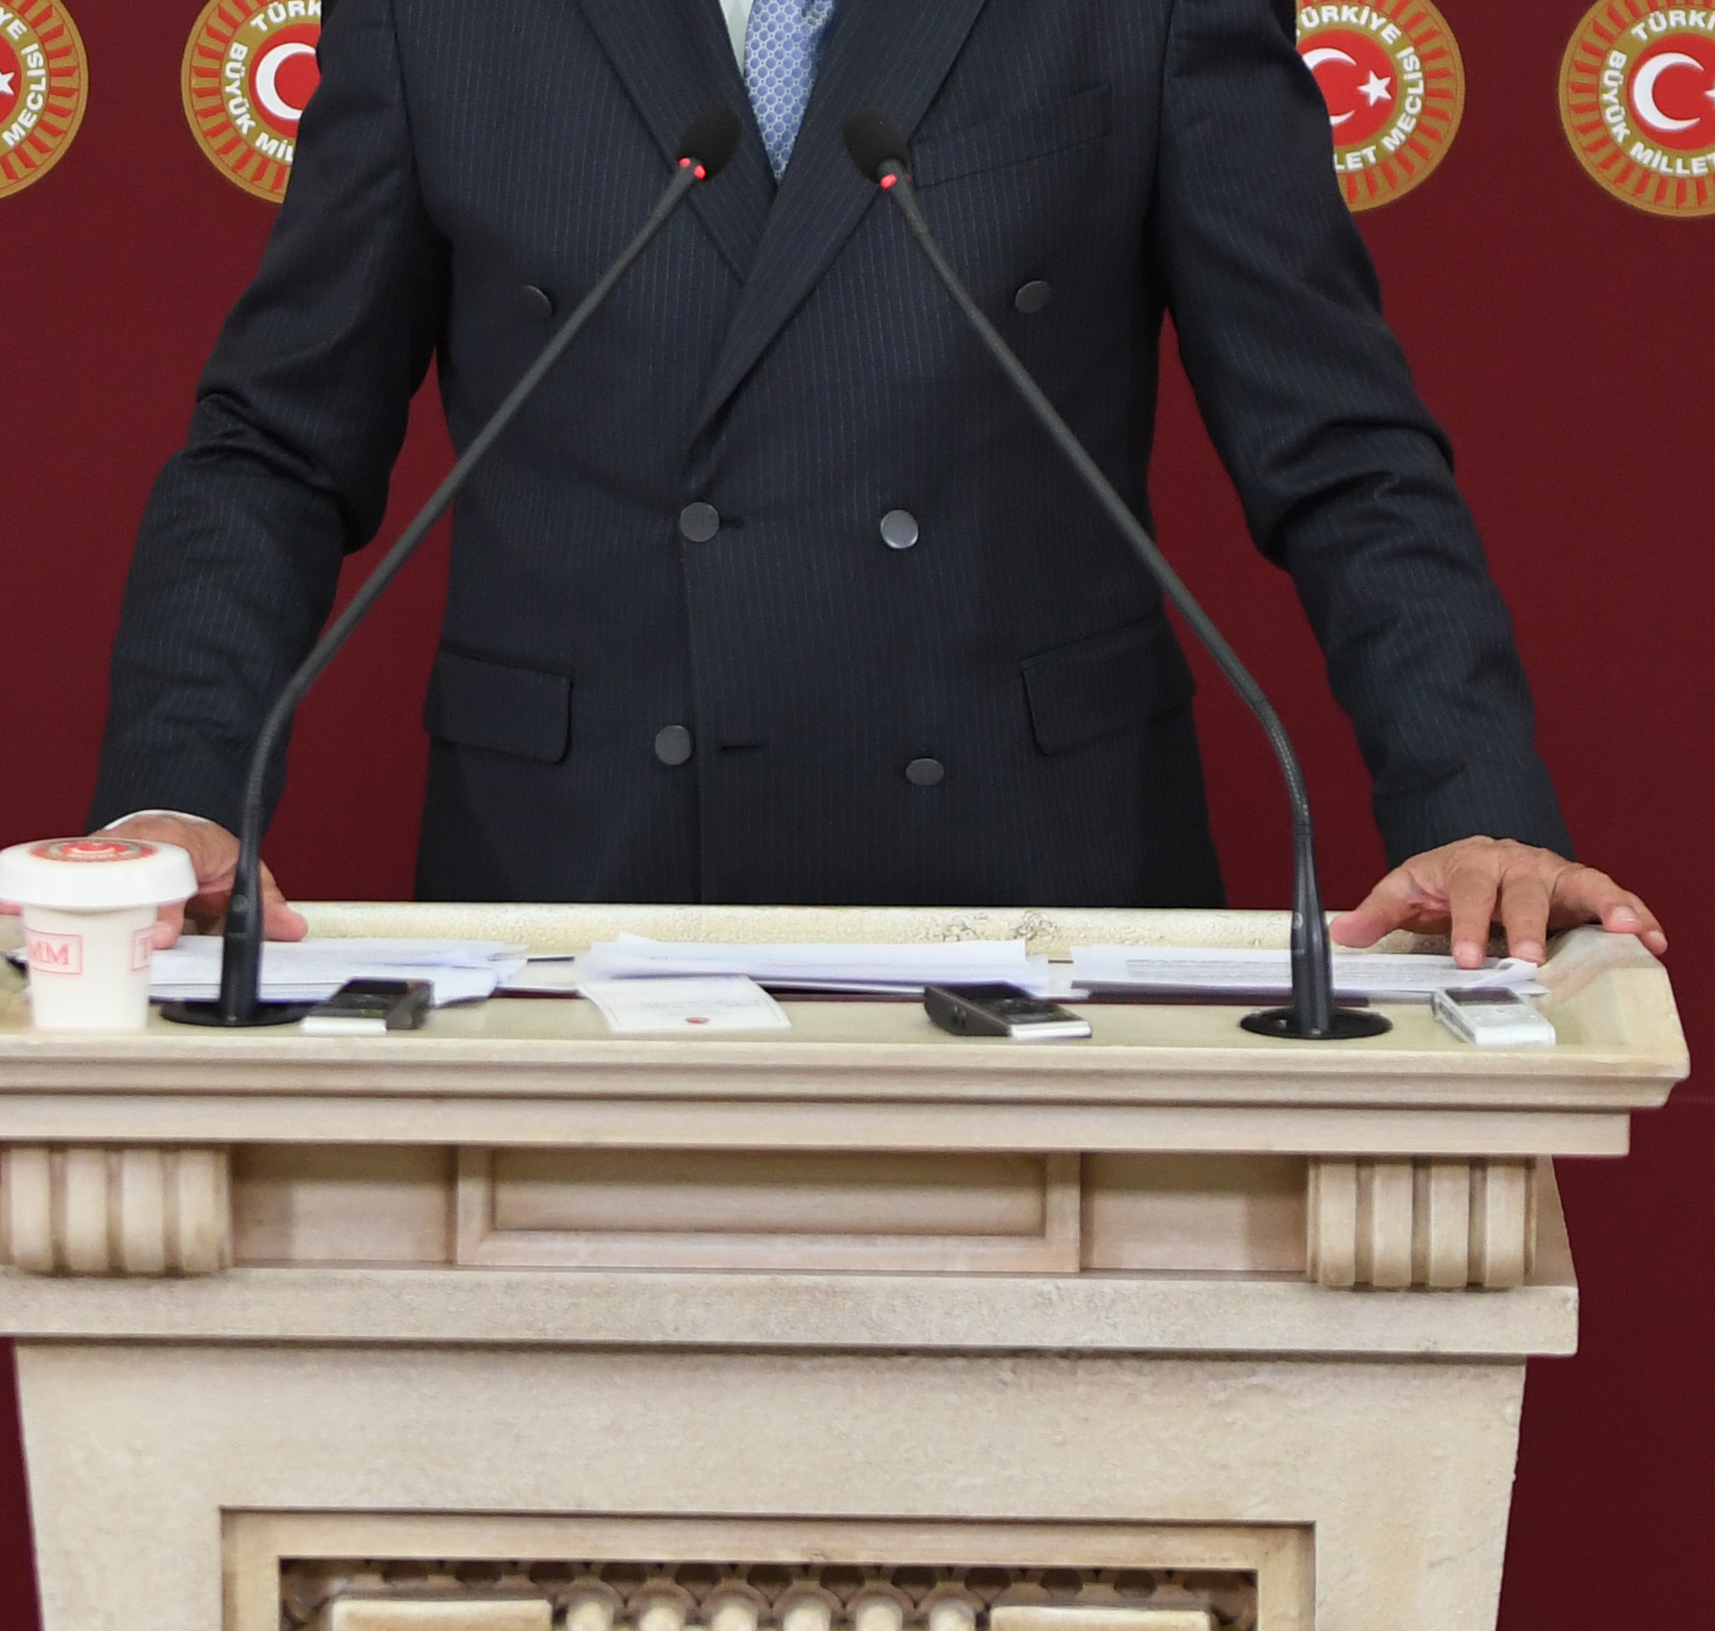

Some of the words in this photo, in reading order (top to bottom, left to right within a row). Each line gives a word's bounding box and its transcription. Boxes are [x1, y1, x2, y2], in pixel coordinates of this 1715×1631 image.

[250, 0, 322, 33] TÜRK
[1295, 5, 1402, 46] ÜRKİYE
[224, 42, 256, 135] BÜYÜK
[254, 132, 294, 164] MİL
[1601, 50, 1631, 144] BÜYÜK
[1333, 145, 1377, 173] LET
